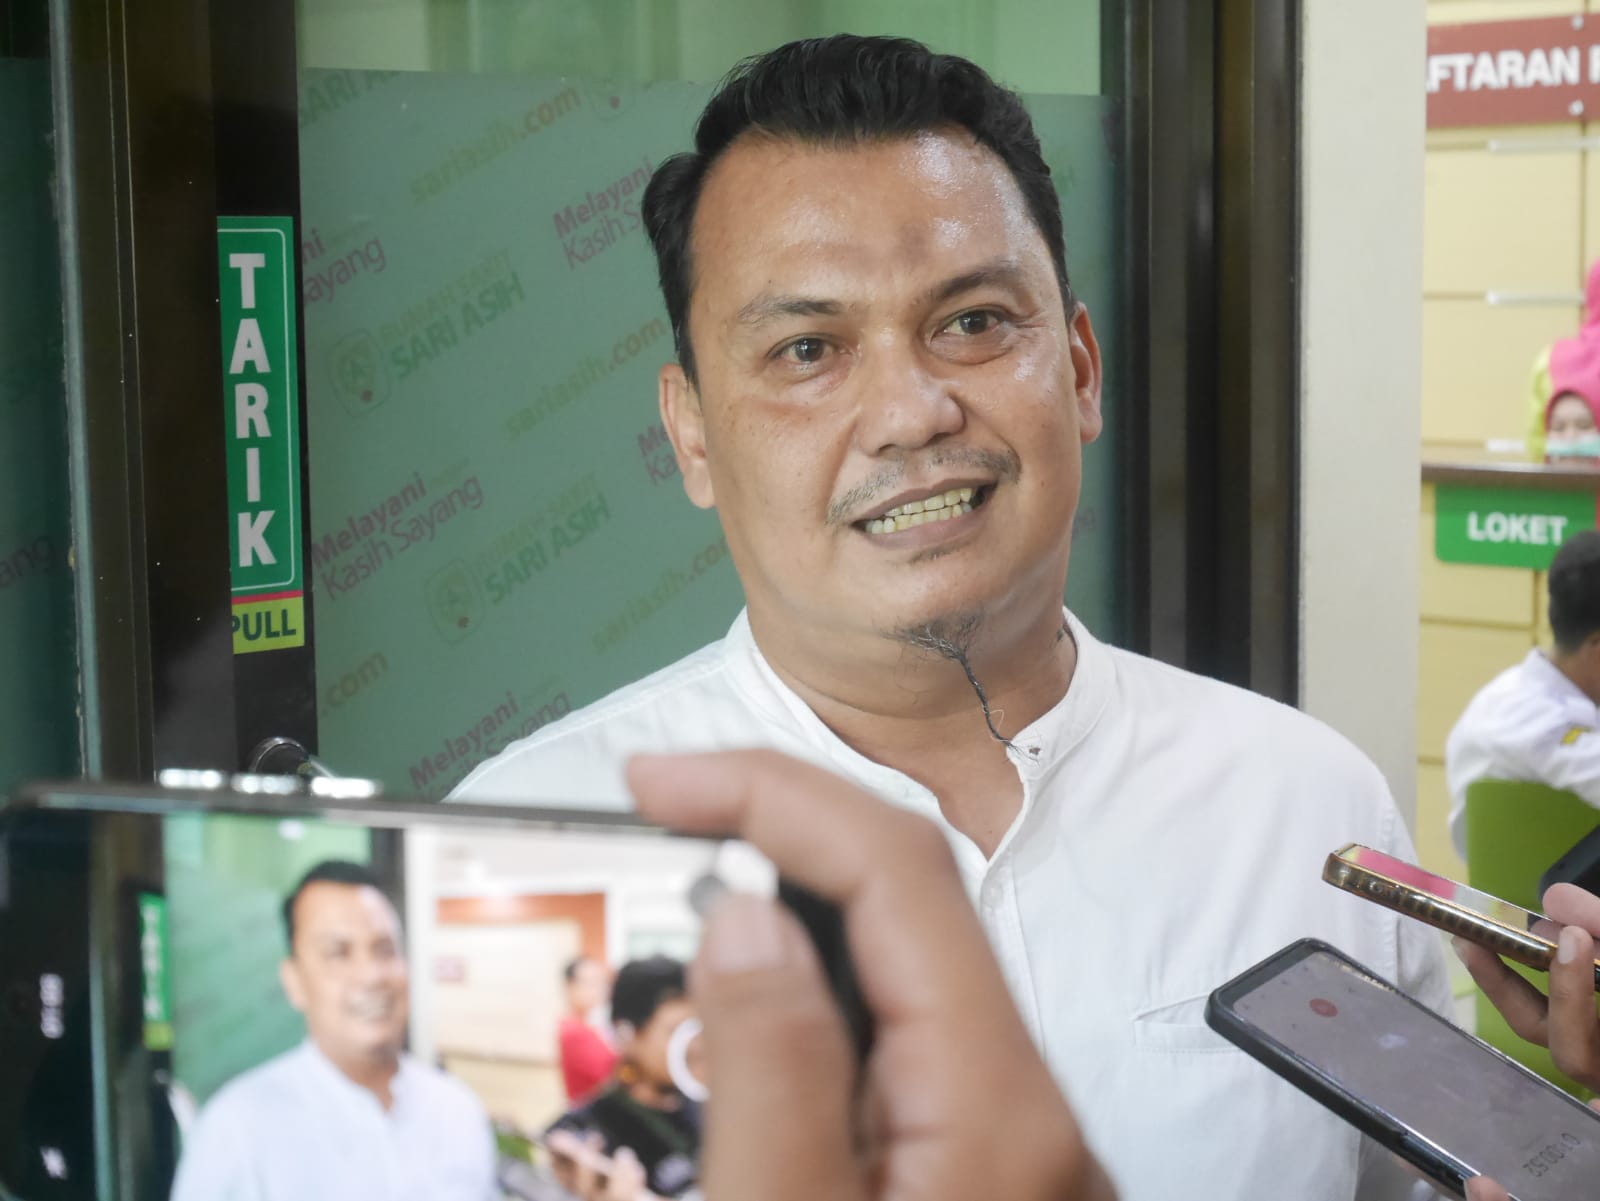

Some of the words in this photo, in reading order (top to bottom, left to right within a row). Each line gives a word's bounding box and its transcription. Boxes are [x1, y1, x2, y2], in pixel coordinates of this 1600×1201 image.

[1426, 46, 1580, 91] FTARAN
[552, 153, 654, 239] Melayani
[563, 215, 626, 271] Kasih
[303, 239, 387, 304] ayang
[391, 315, 458, 381] SARI
[461, 269, 526, 337] ASIH
[229, 253, 277, 568] TARIK
[311, 471, 427, 569] Melayani
[321, 537, 395, 602] Kasih
[390, 475, 484, 553] Sayang
[484, 539, 548, 606] SARI
[551, 489, 612, 559] ASIH
[1467, 511, 1568, 546] LOKET
[409, 690, 520, 790] Melayani
